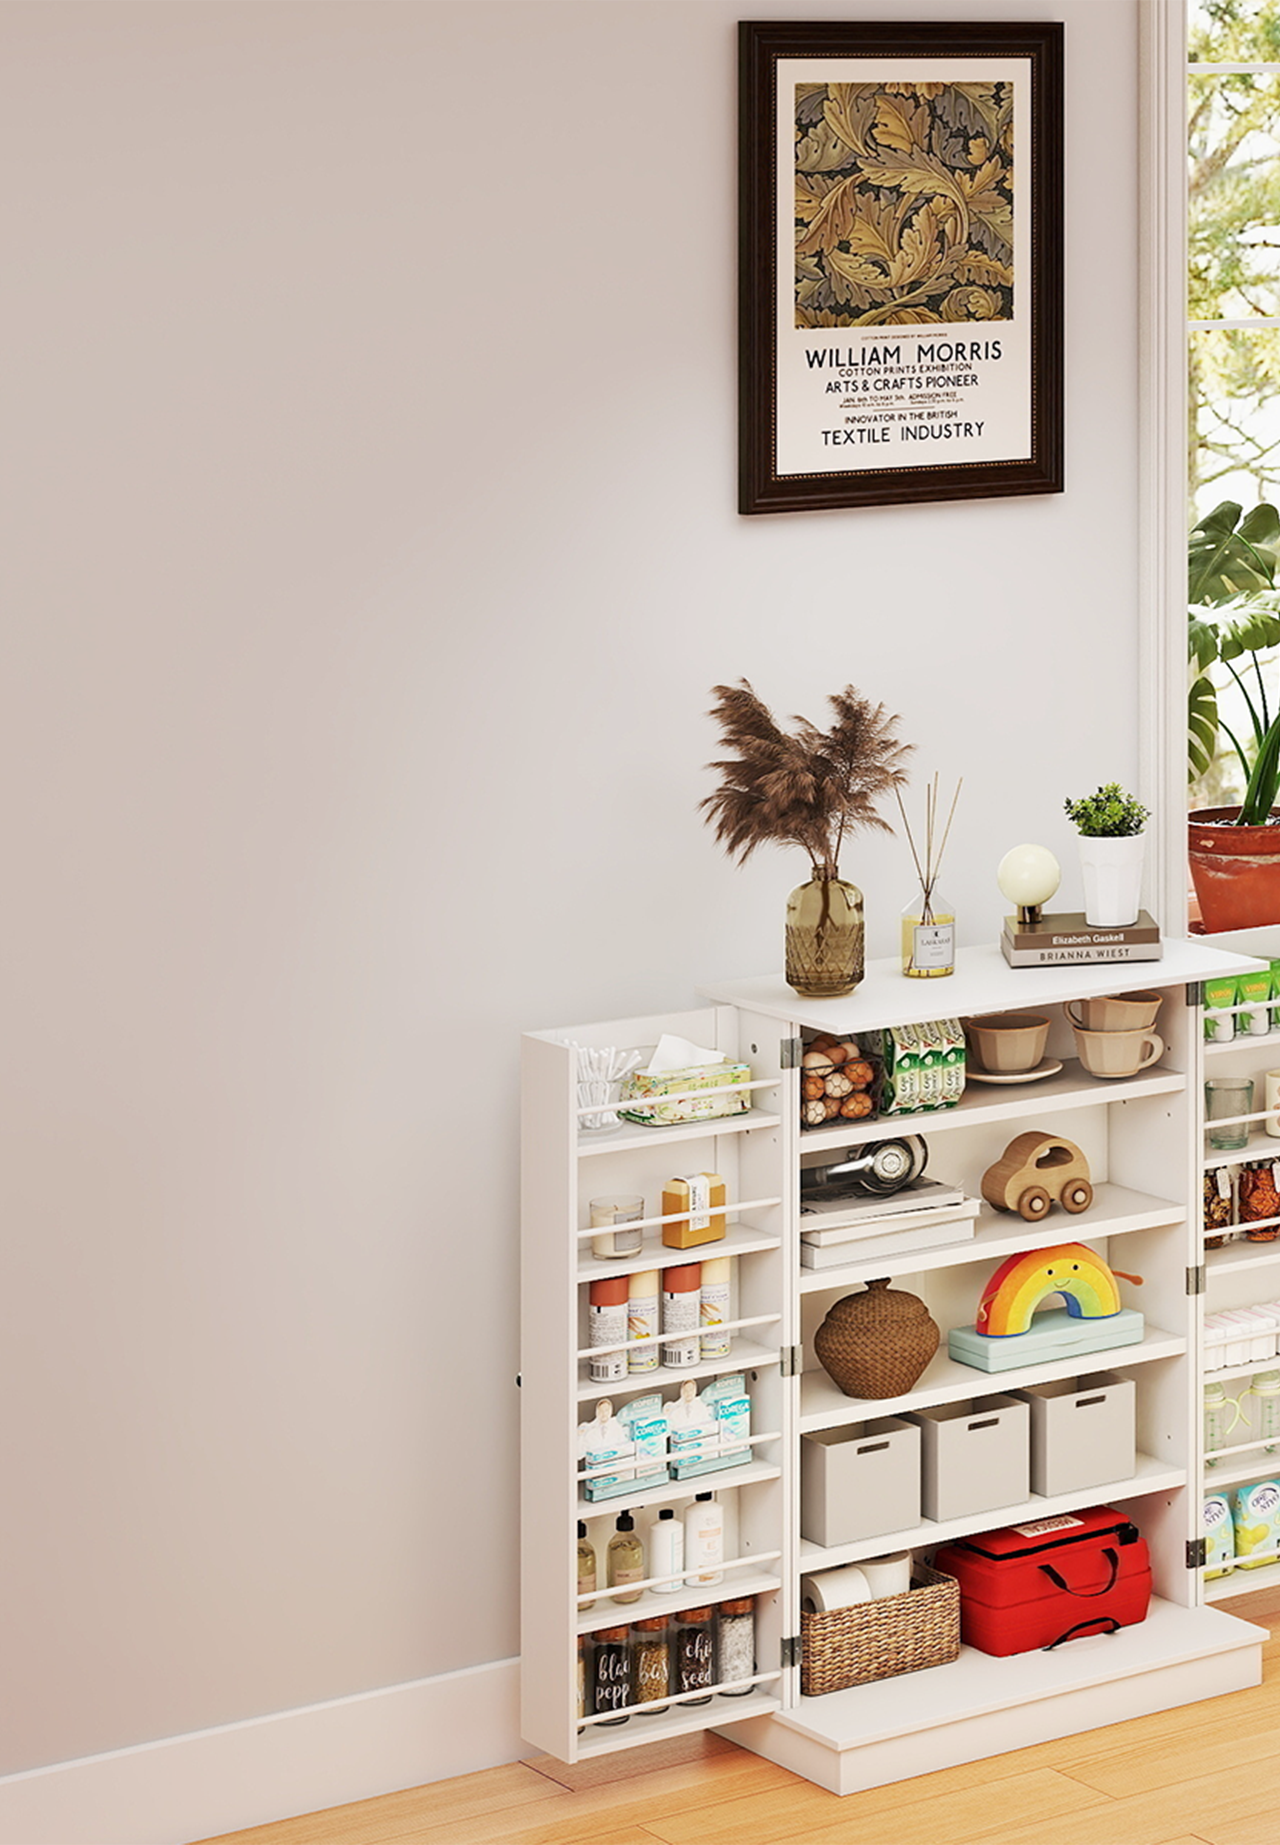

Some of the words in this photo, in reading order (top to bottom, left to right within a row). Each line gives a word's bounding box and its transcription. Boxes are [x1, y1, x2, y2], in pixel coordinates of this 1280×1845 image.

[805, 345, 900, 369] WILLIAM
[917, 341, 1002, 363] MORRIS
[838, 367, 881, 377] COTTON
[883, 364, 916, 375] PRINTS
[919, 362, 972, 374] EXHIBITION
[825, 379, 859, 393] ARTS
[861, 379, 870, 391] &
[873, 376, 923, 391] CRAFTS
[926, 374, 979, 388] PIONEER
[845, 413, 896, 424] INNOVATOR
[898, 413, 907, 421] IN
[909, 412, 925, 421] THE
[927, 410, 958, 420] BRITISH
[821, 426, 890, 445] TEXTILE
[901, 422, 984, 441] INDUSTRY
[1052, 934, 1091, 945] Elizabeth
[1093, 932, 1124, 943] Gaskell
[1039, 951, 1091, 961] BRIANNA
[1097, 948, 1130, 958] WIEST
